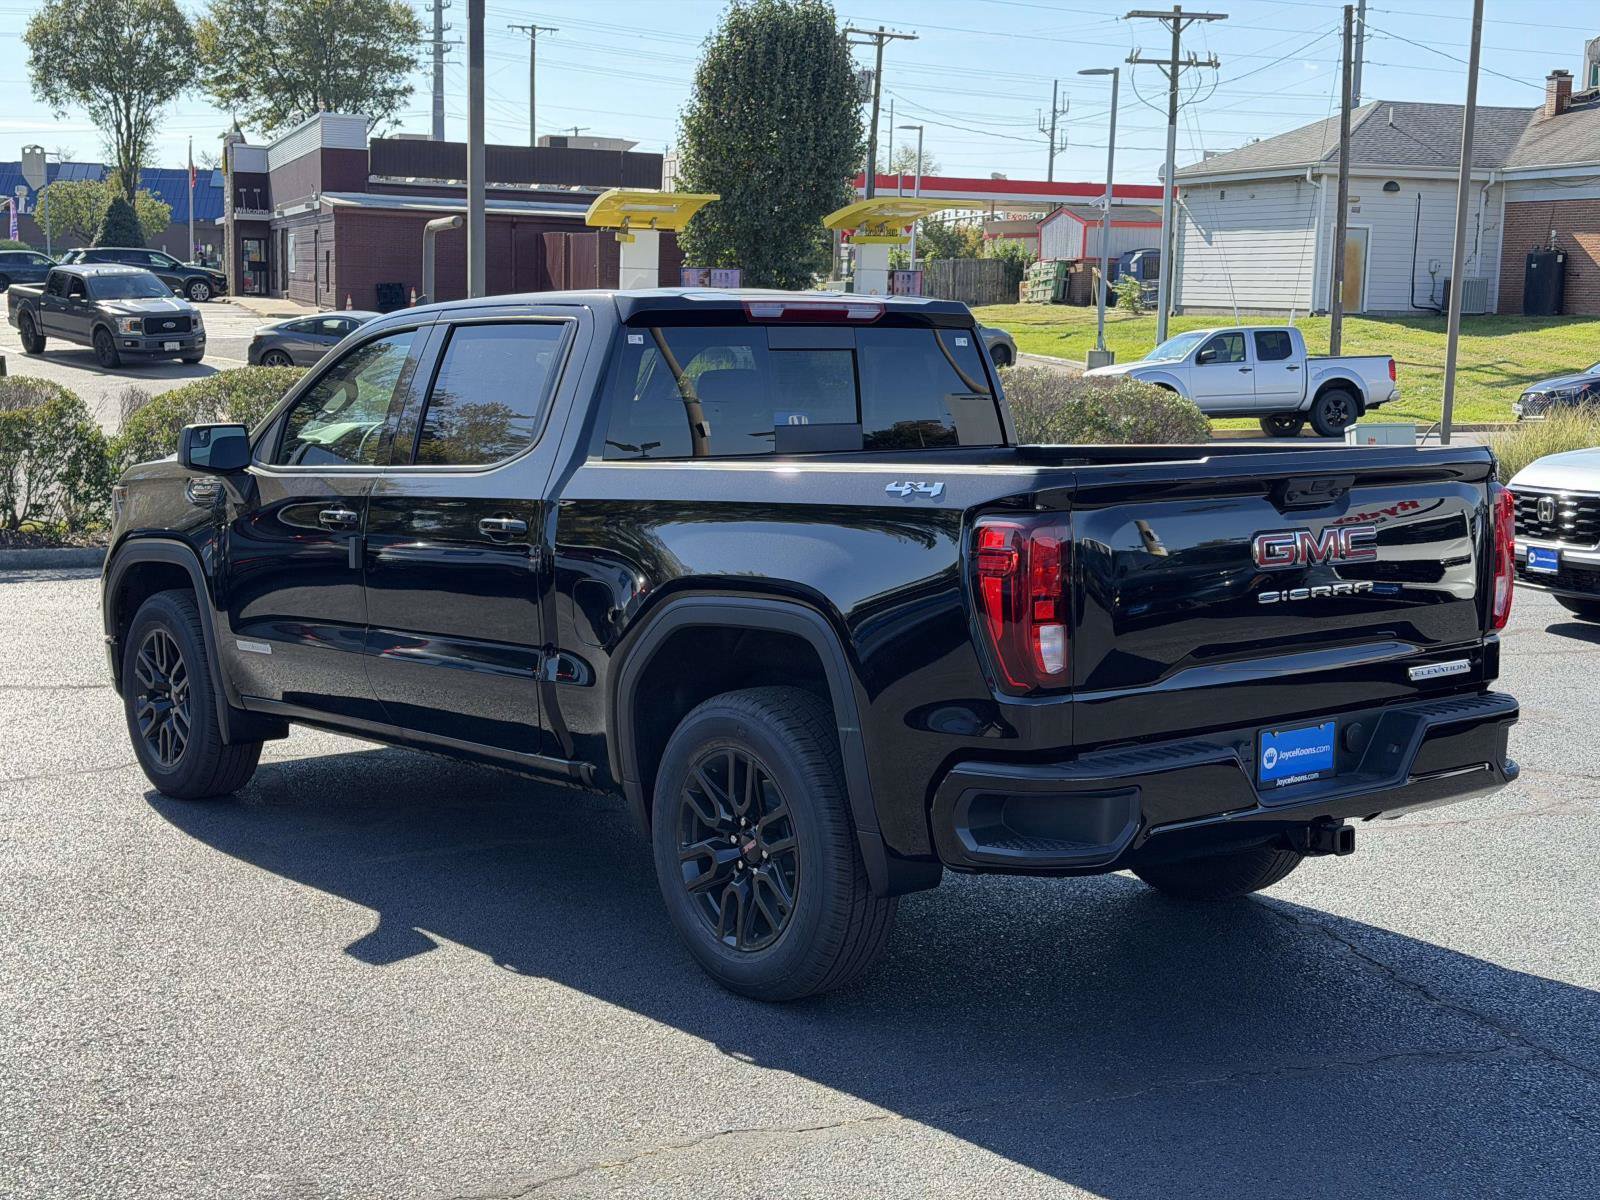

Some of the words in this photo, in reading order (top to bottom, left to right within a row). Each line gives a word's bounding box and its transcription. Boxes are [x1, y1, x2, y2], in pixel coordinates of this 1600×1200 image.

[234, 206, 269, 216] Welcome
[1253, 522, 1378, 572] GMC
[1258, 581, 1374, 604] SIERRA
[1414, 662, 1468, 677] ELEVATION
[1279, 744, 1331, 760] JoyceKoons.com
[1276, 772, 1320, 787] JoyceKoons.com
